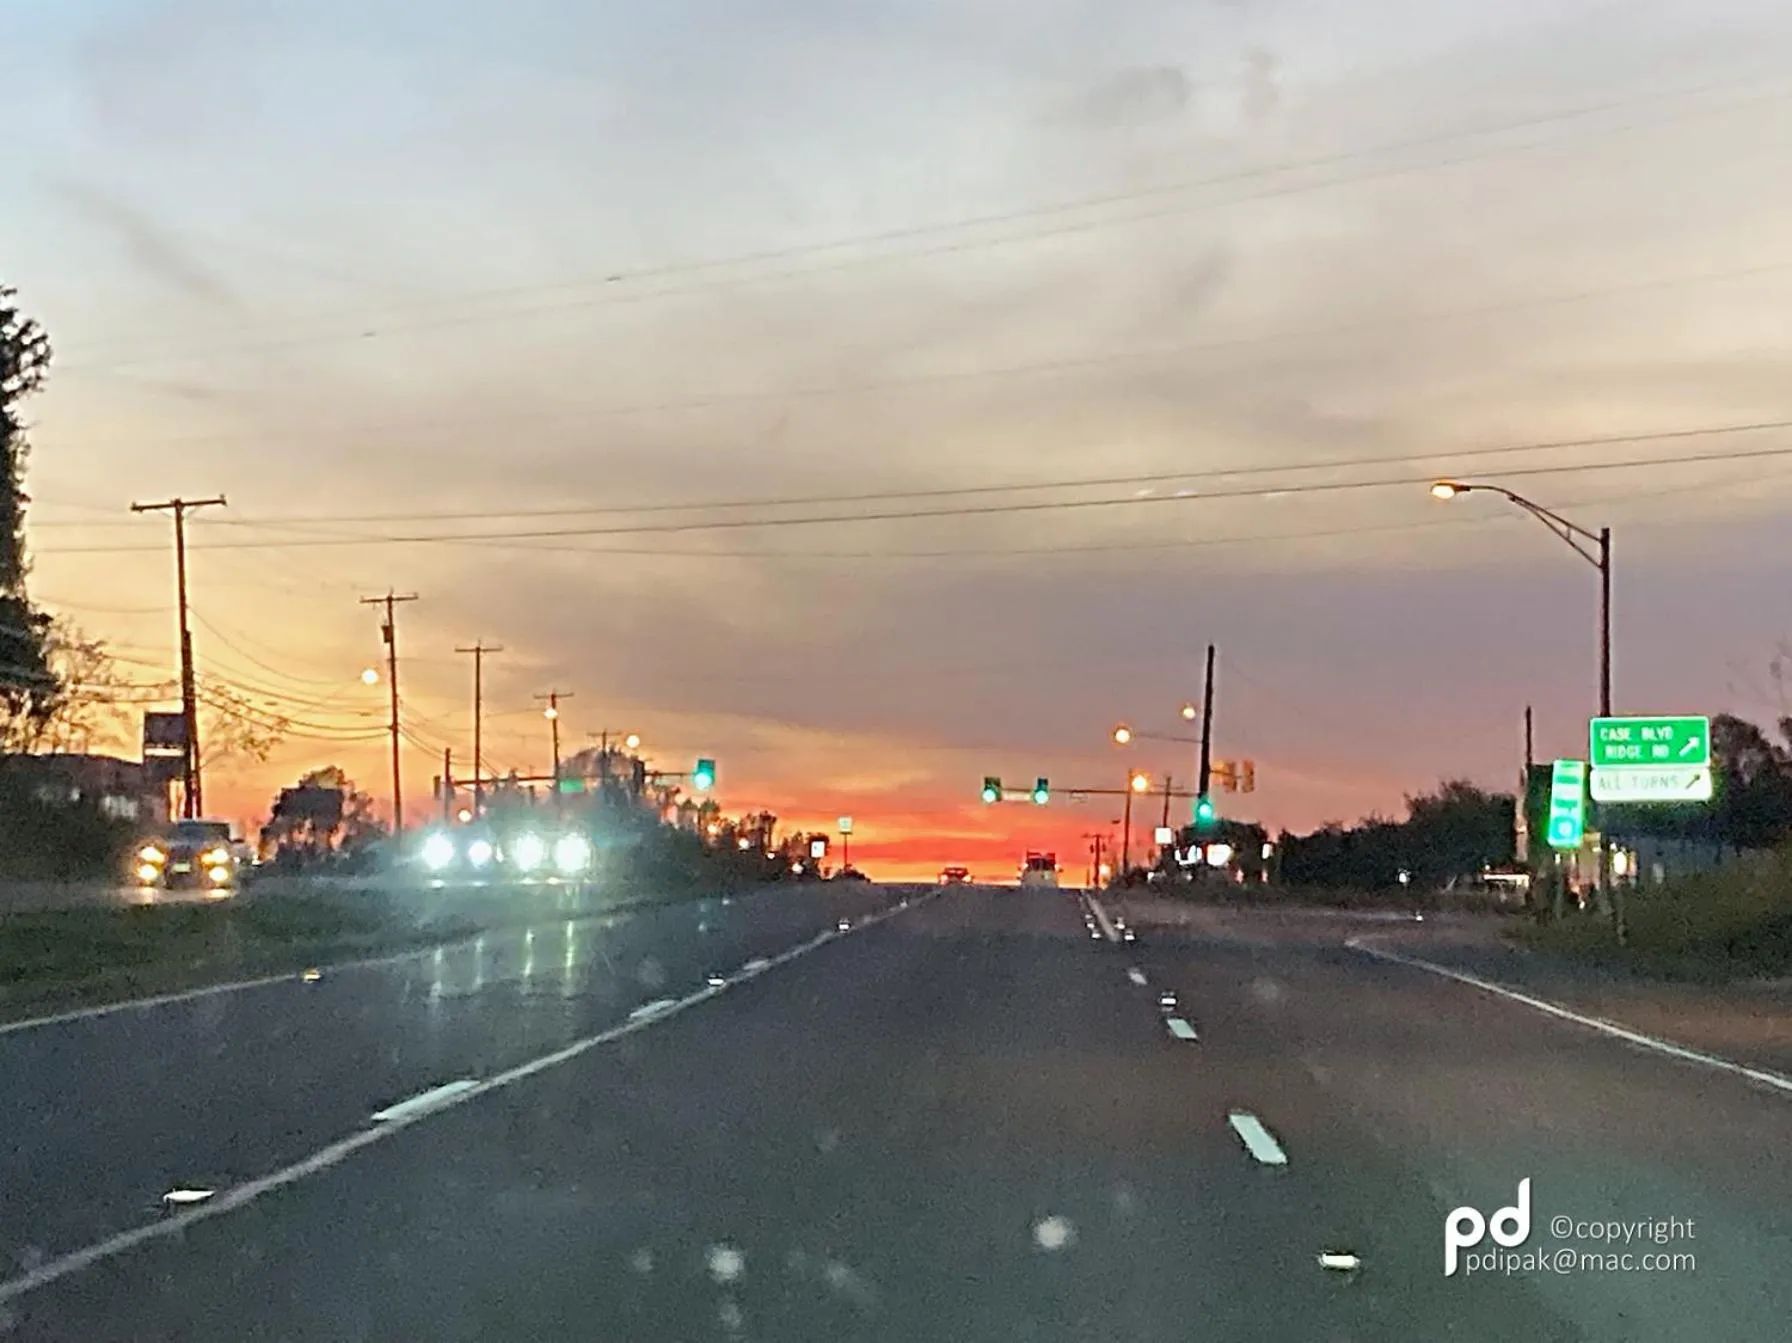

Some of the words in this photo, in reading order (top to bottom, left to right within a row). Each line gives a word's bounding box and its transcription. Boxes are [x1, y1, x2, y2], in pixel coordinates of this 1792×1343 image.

[1600, 728, 1631, 741] CASE
[1641, 726, 1673, 740] BLVD
[1599, 777, 1621, 791] ALL
[1632, 775, 1678, 790] TURNS
